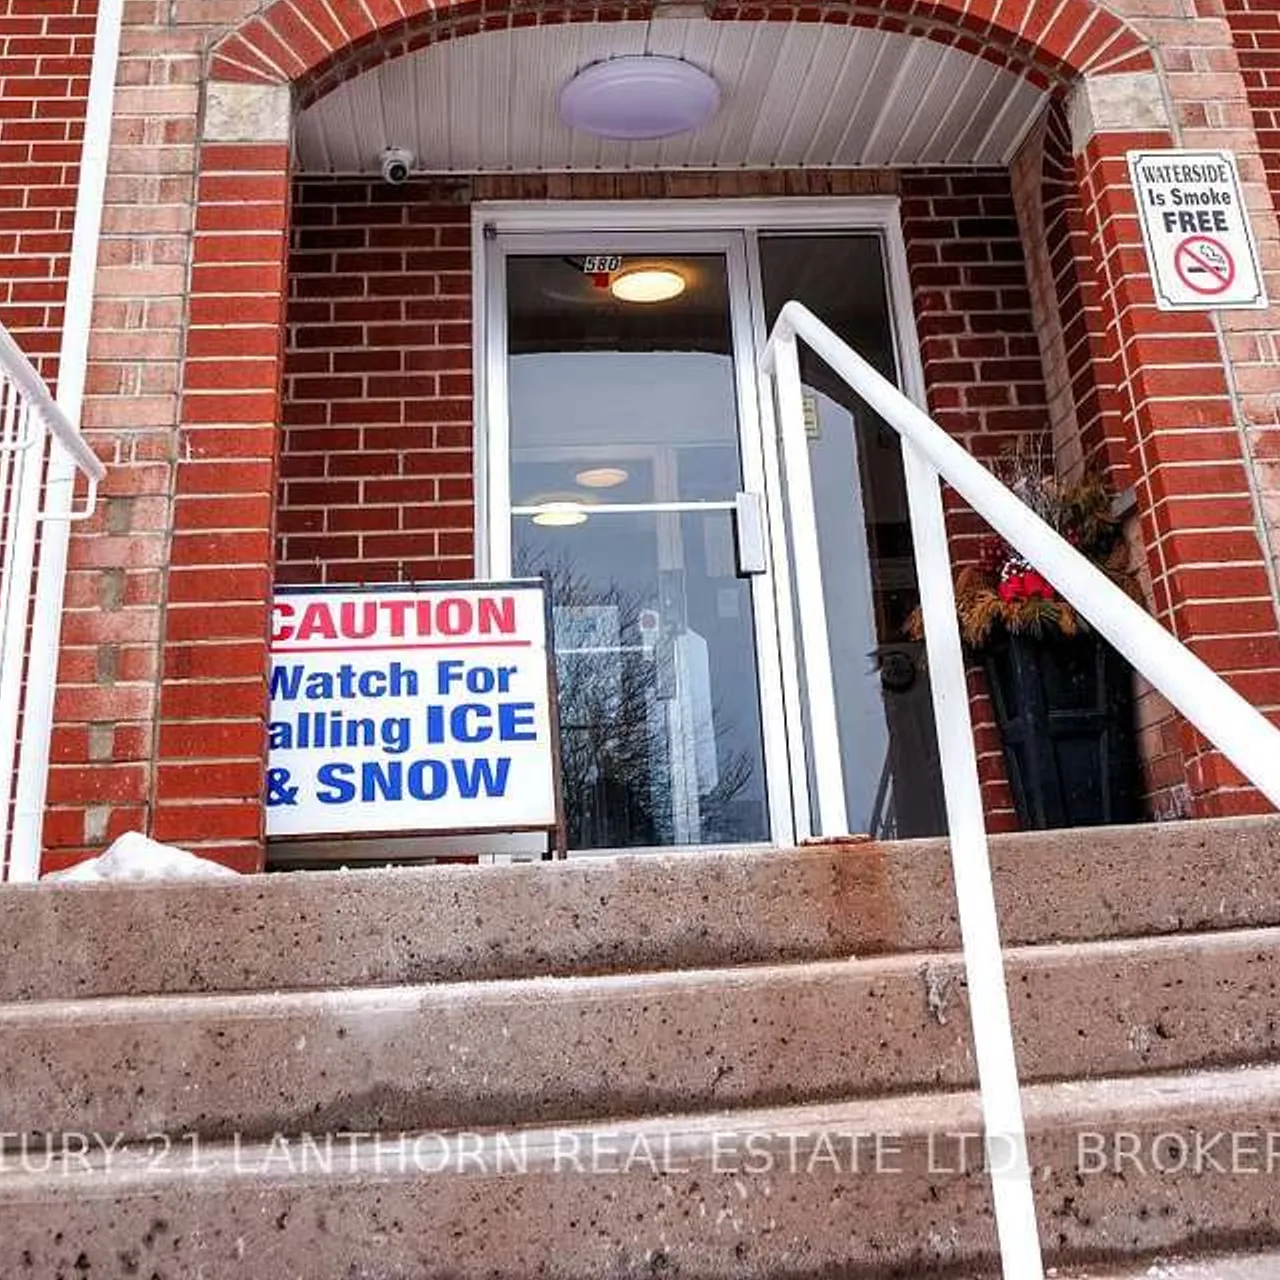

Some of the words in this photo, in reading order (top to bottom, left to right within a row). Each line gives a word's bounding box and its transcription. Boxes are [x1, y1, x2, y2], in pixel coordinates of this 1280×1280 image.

[1142, 164, 1229, 183] WATERSIDE
[1147, 188, 1165, 206] Is
[1170, 187, 1231, 206] Smoke
[1162, 210, 1229, 233] FREE
[583, 257, 620, 271] 580
[270, 597, 516, 641] CAUTION
[270, 662, 418, 701] Watch
[437, 660, 517, 695] For
[269, 710, 411, 754] alling
[427, 702, 537, 744] ICE
[266, 767, 299, 806] &
[316, 758, 512, 805] SNOW
